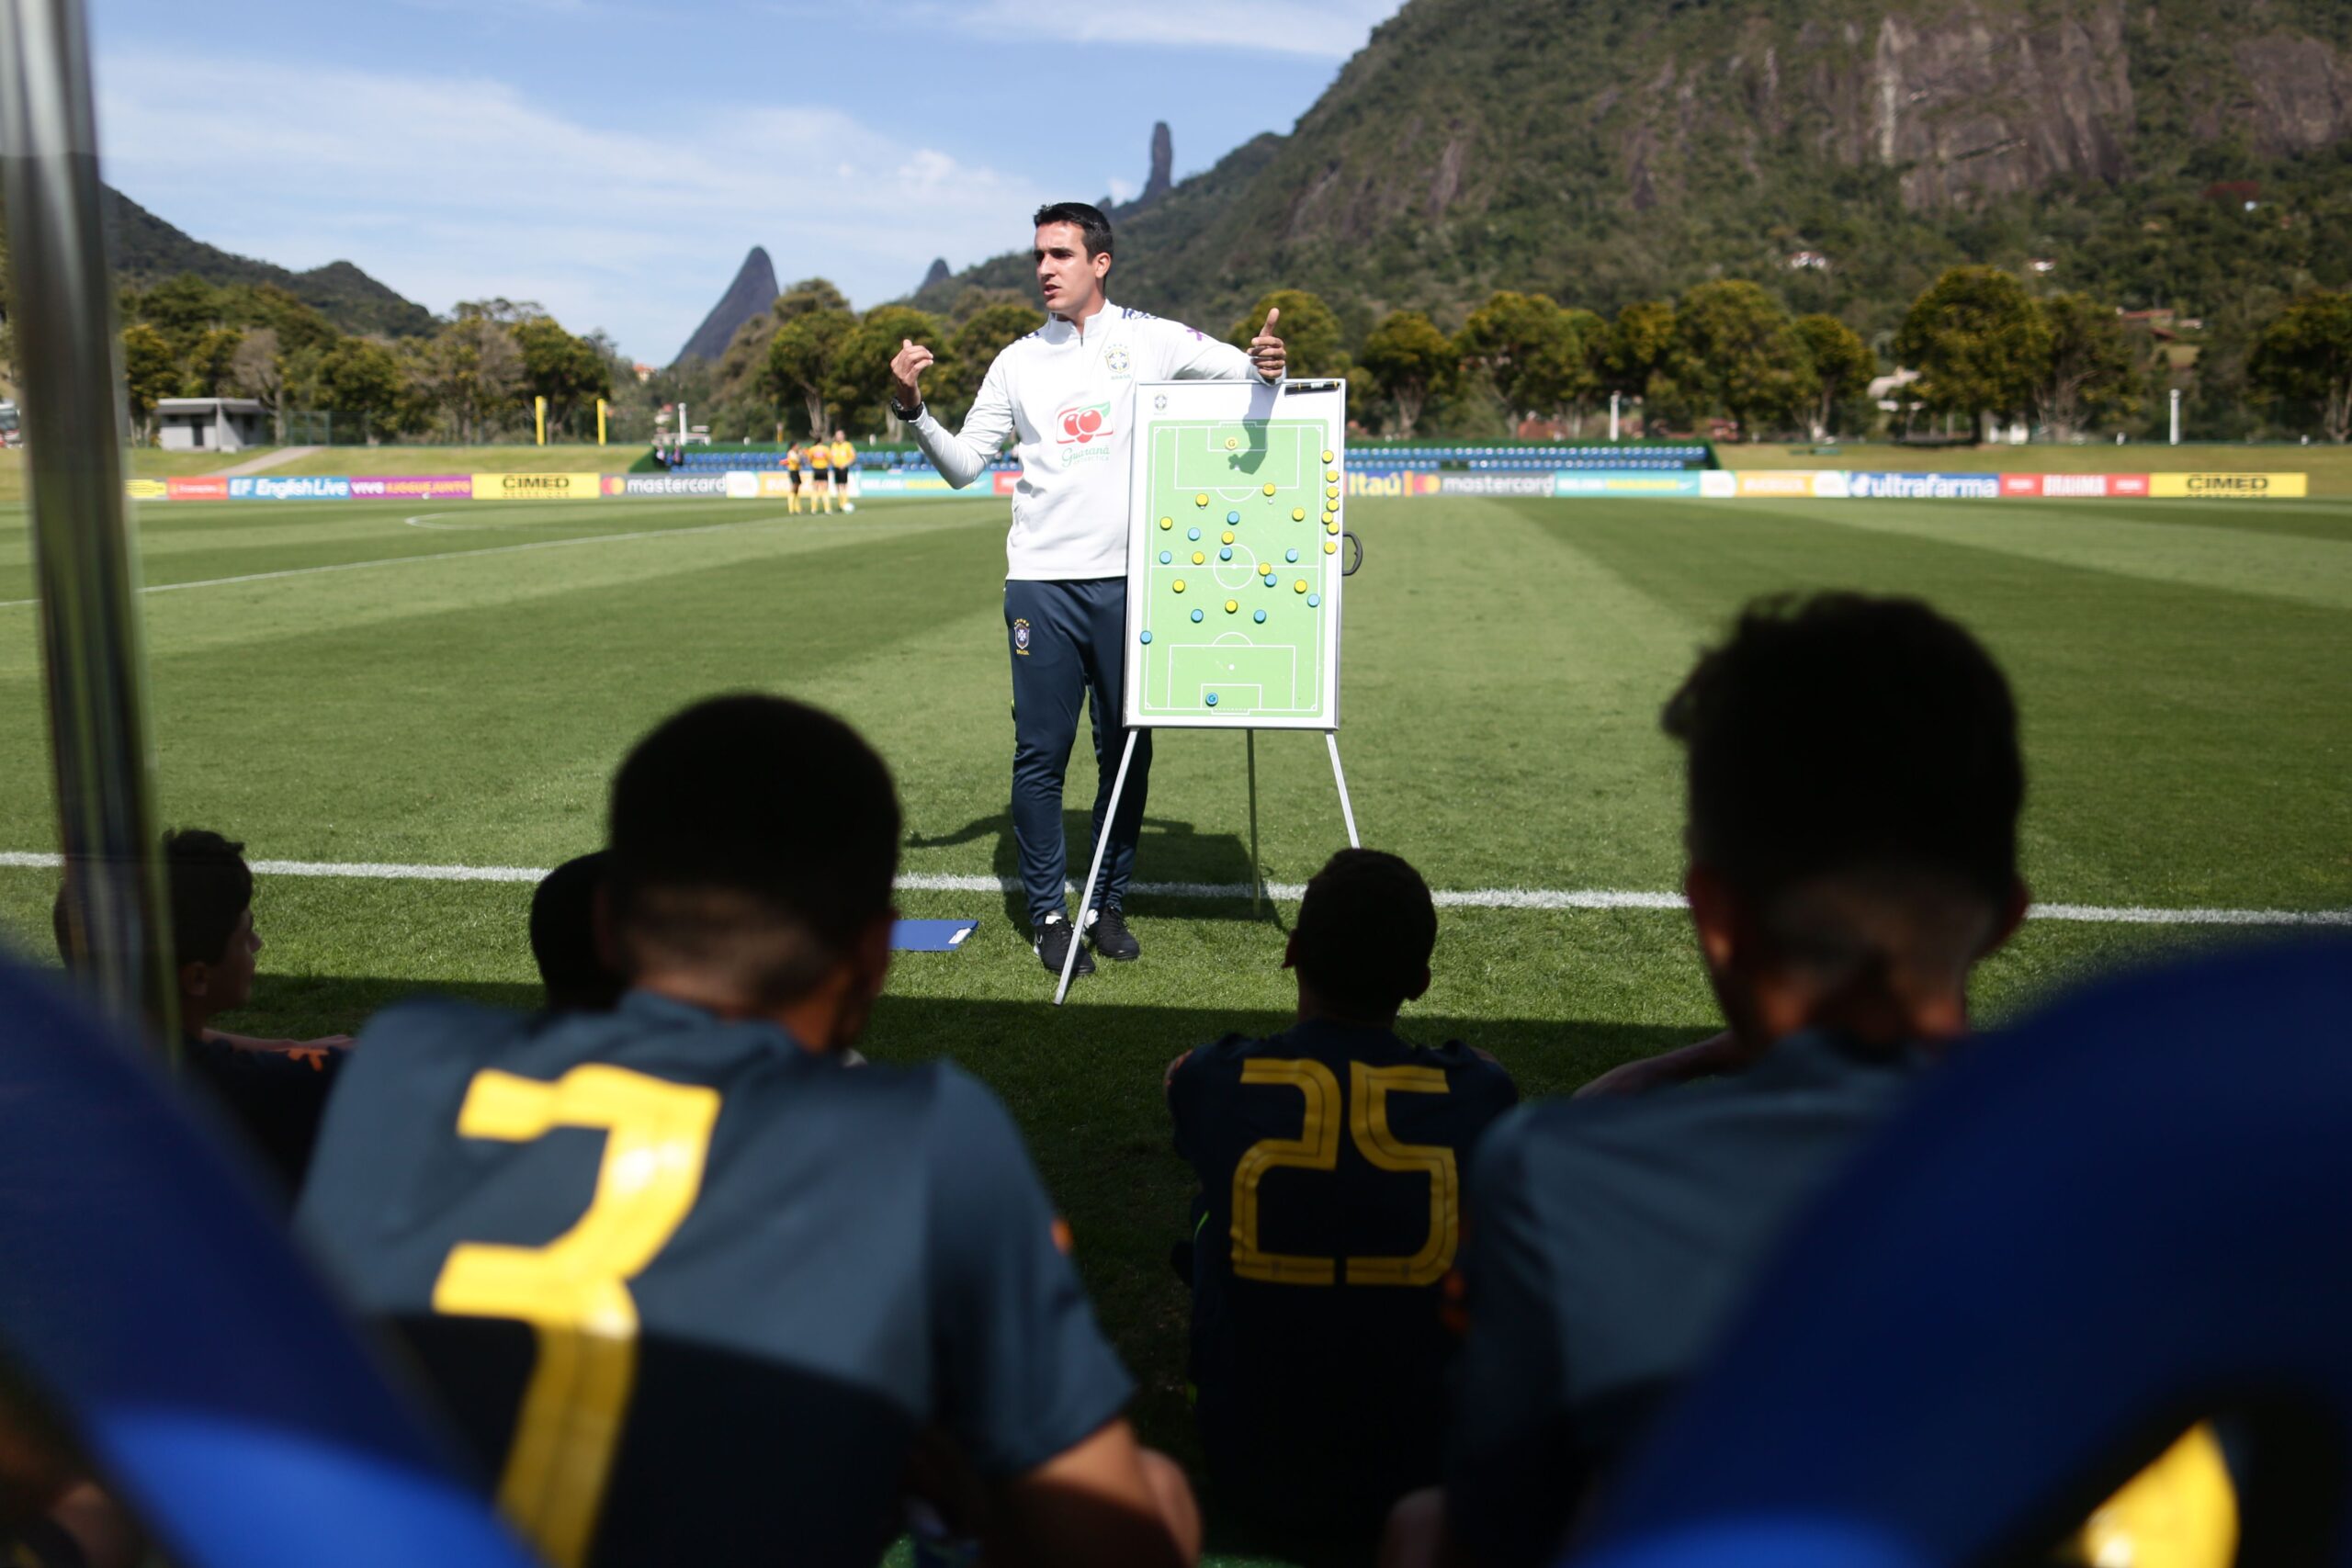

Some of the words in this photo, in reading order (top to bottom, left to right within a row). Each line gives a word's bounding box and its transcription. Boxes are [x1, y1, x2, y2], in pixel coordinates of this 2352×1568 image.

[230, 479, 254, 496] EF
[255, 478, 312, 500] English
[313, 478, 348, 496] Live
[350, 481, 384, 494] vivo
[503, 477, 570, 489] CIMED
[628, 476, 726, 493] mastercard
[1348, 471, 1401, 496] Itaú
[1442, 474, 1555, 494] mastercard
[1871, 473, 1997, 498] ultrafarma
[2186, 476, 2268, 491] CIMED
[1229, 1058, 1459, 1286] 25
